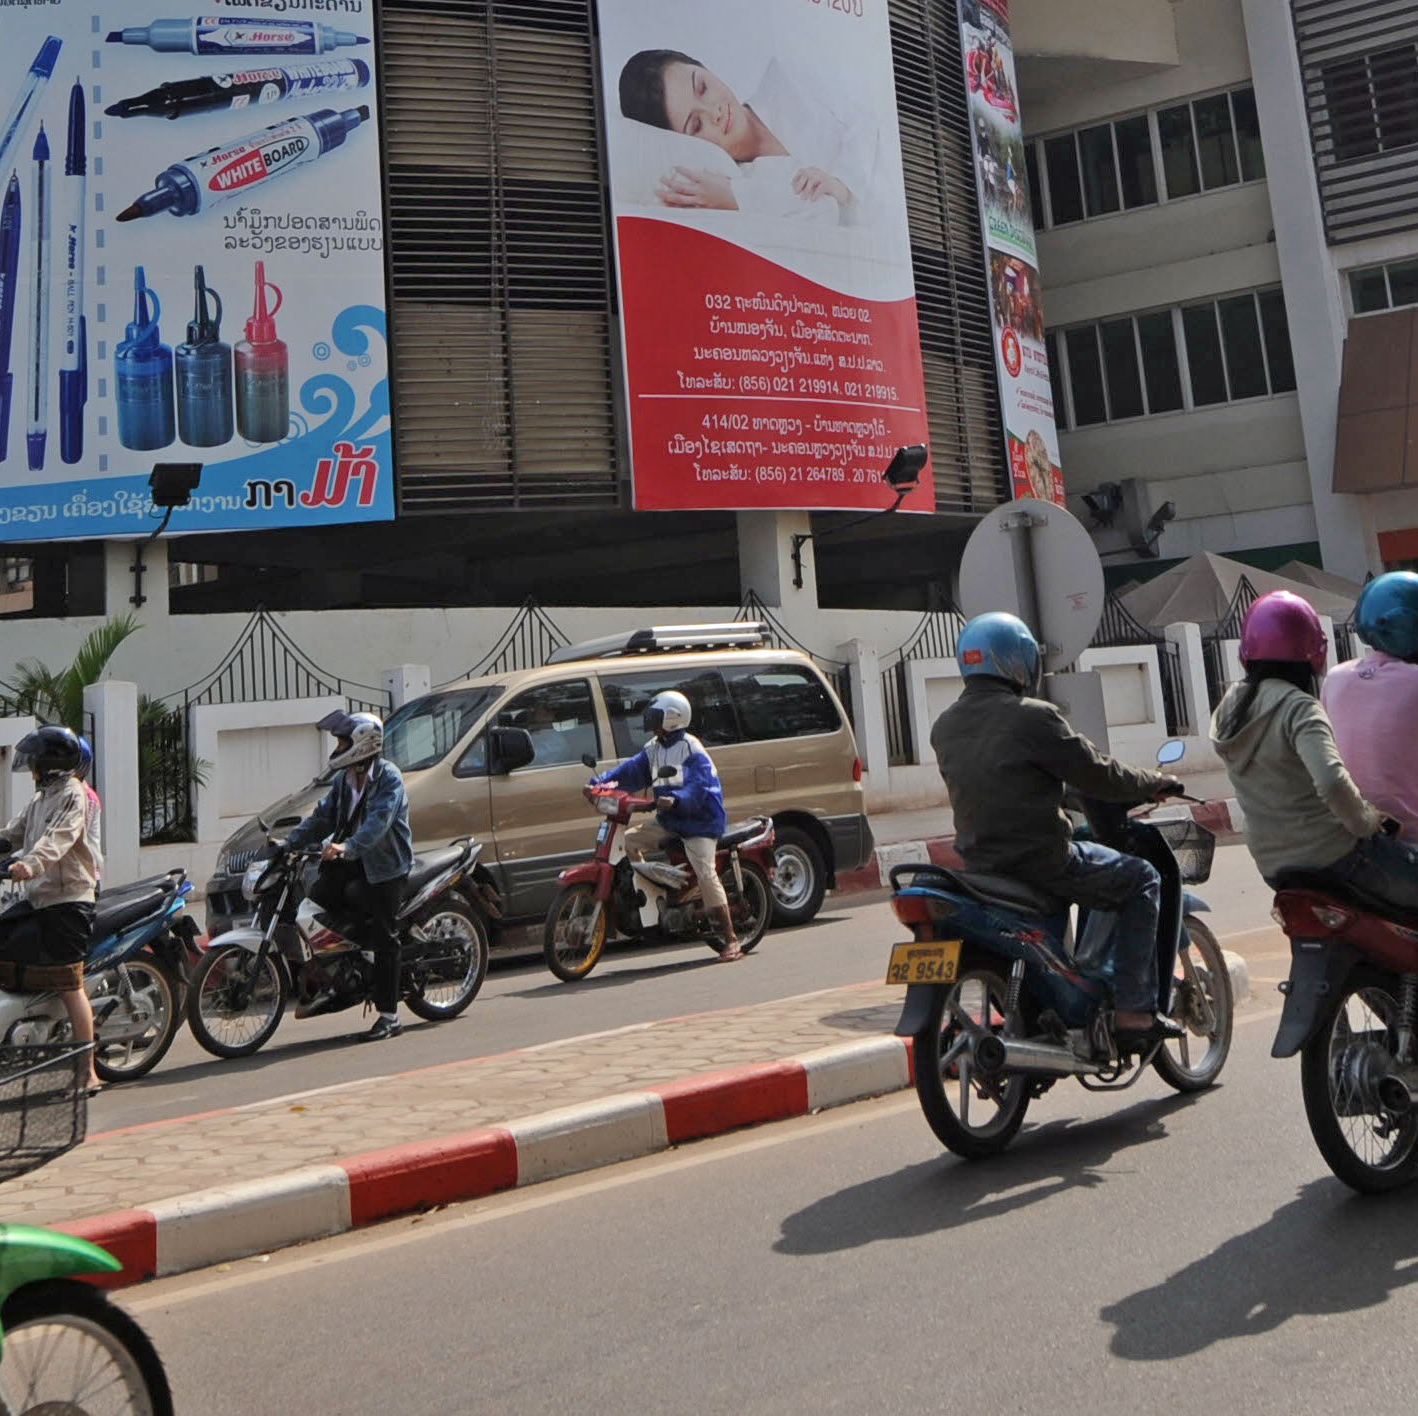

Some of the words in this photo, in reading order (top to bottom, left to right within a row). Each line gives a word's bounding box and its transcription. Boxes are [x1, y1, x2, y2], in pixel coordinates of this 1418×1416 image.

[249, 31, 294, 42] Horse
[233, 68, 283, 84] Horse
[210, 146, 247, 166] Horse
[216, 157, 264, 189] WHITE
[264, 139, 305, 167] BOARD
[705, 294, 731, 310] 032
[677, 370, 736, 390] ໂທລະສັບ:
[738, 375, 772, 394] (856)
[773, 376, 796, 393] 021
[844, 379, 863, 397] 021
[701, 413, 750, 431] 414/02
[693, 462, 752, 482] ໂທລະສັບ:
[754, 467, 788, 485] (856)
[789, 467, 804, 482] 21
[806, 466, 845, 482] 264789
[852, 468, 864, 483] 20
[916, 960, 955, 980] 9543
